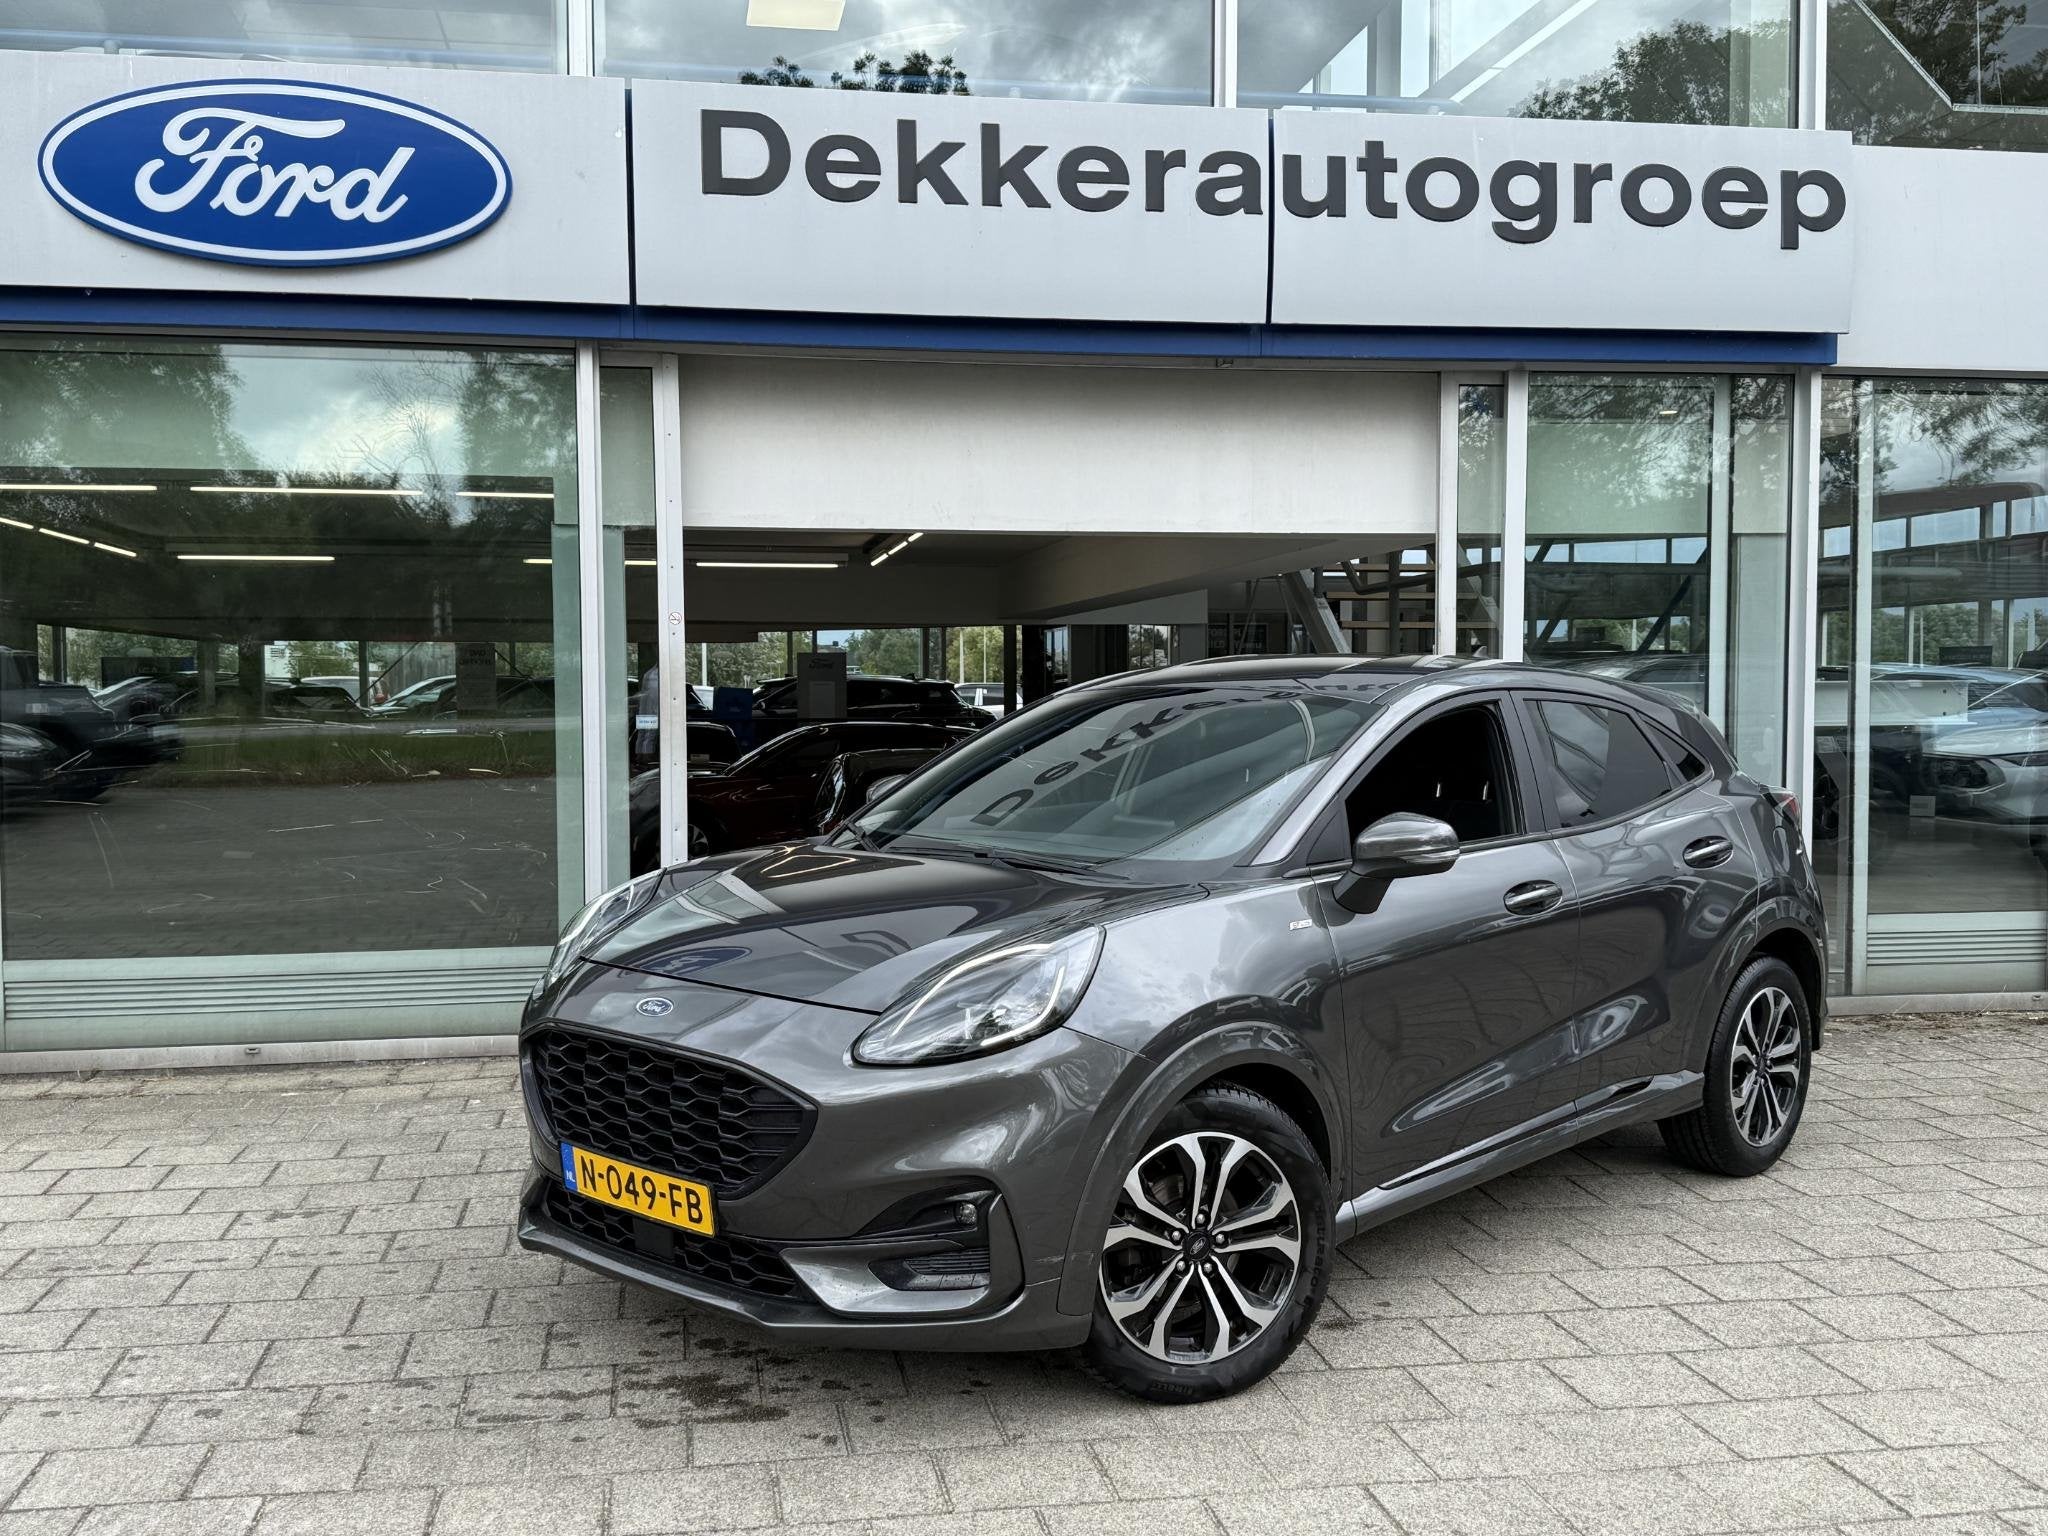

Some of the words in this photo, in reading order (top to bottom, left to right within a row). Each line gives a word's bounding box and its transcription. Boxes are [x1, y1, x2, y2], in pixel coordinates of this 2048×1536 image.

[134, 107, 415, 224] Ford
[700, 108, 1847, 251] Dekkerautogroep
[580, 1155, 704, 1225] N-049-FB
